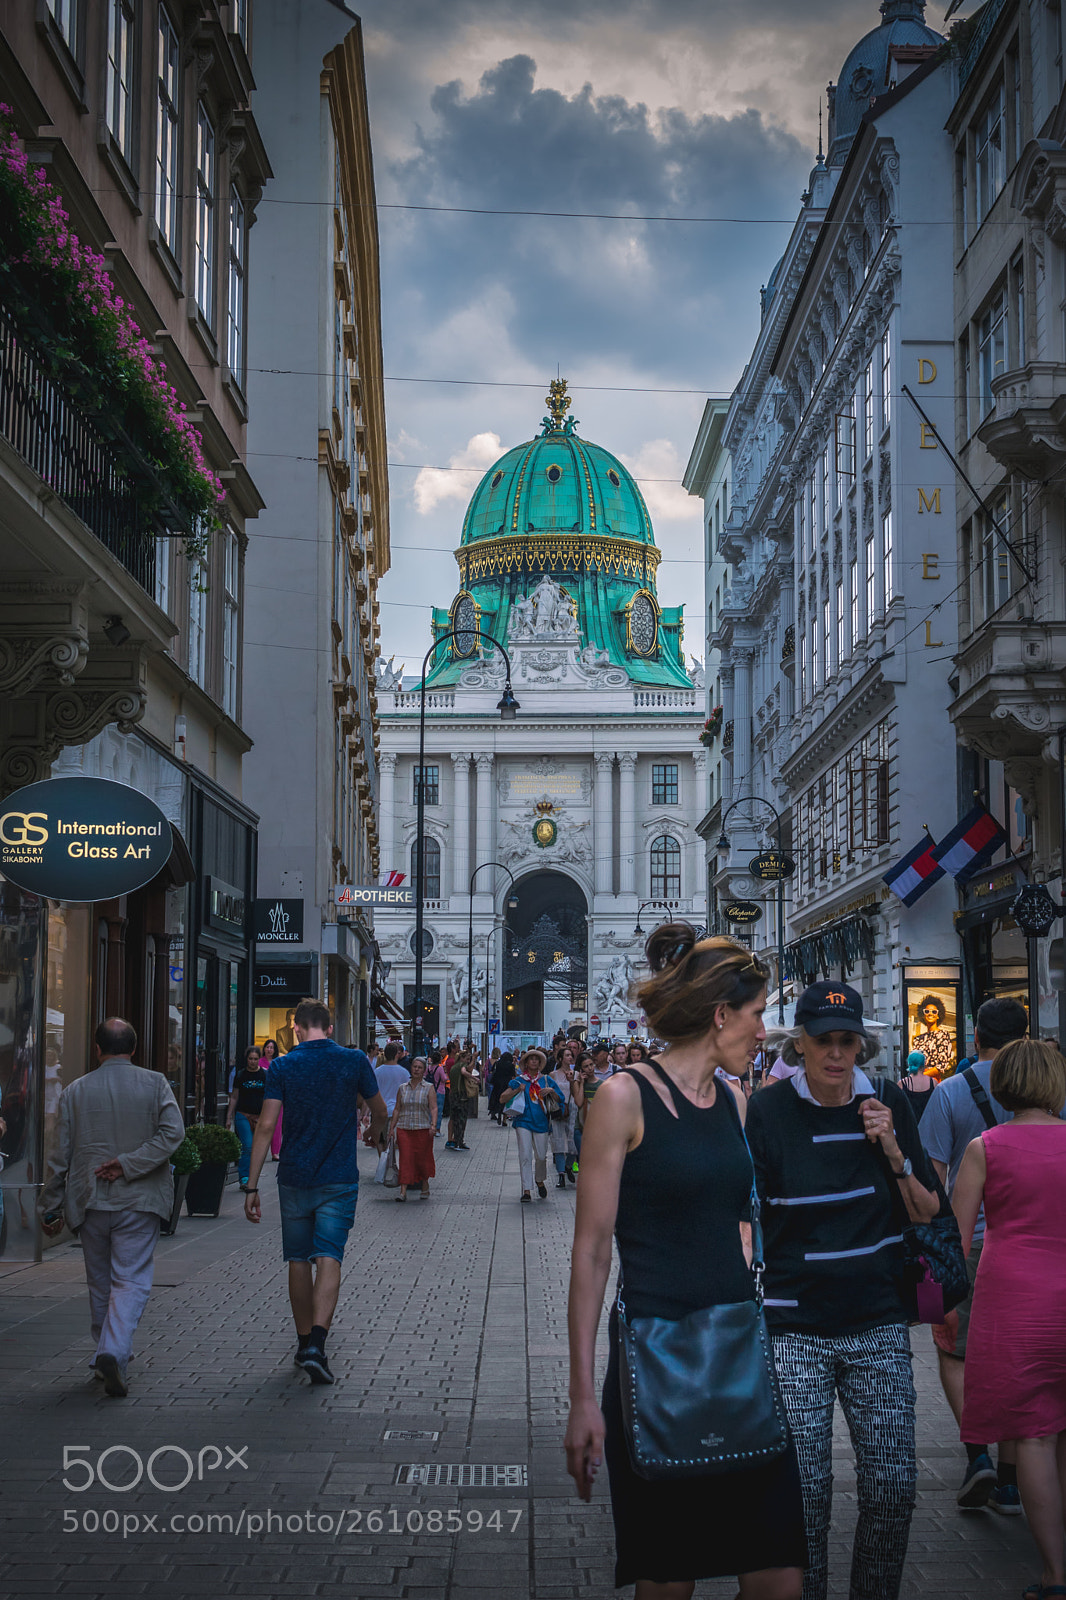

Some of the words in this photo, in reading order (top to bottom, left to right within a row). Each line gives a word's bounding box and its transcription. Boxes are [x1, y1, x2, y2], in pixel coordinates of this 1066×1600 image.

[917, 358, 944, 647] DEMEL
[57, 819, 162, 836] International
[2, 847, 44, 855] GALLERY
[67, 841, 118, 858] Glass
[123, 843, 151, 859] Art
[338, 887, 413, 904] APOTHEKE
[726, 906, 759, 917] Chopard
[257, 932, 300, 941] MONCLER
[259, 974, 288, 987] Dutti
